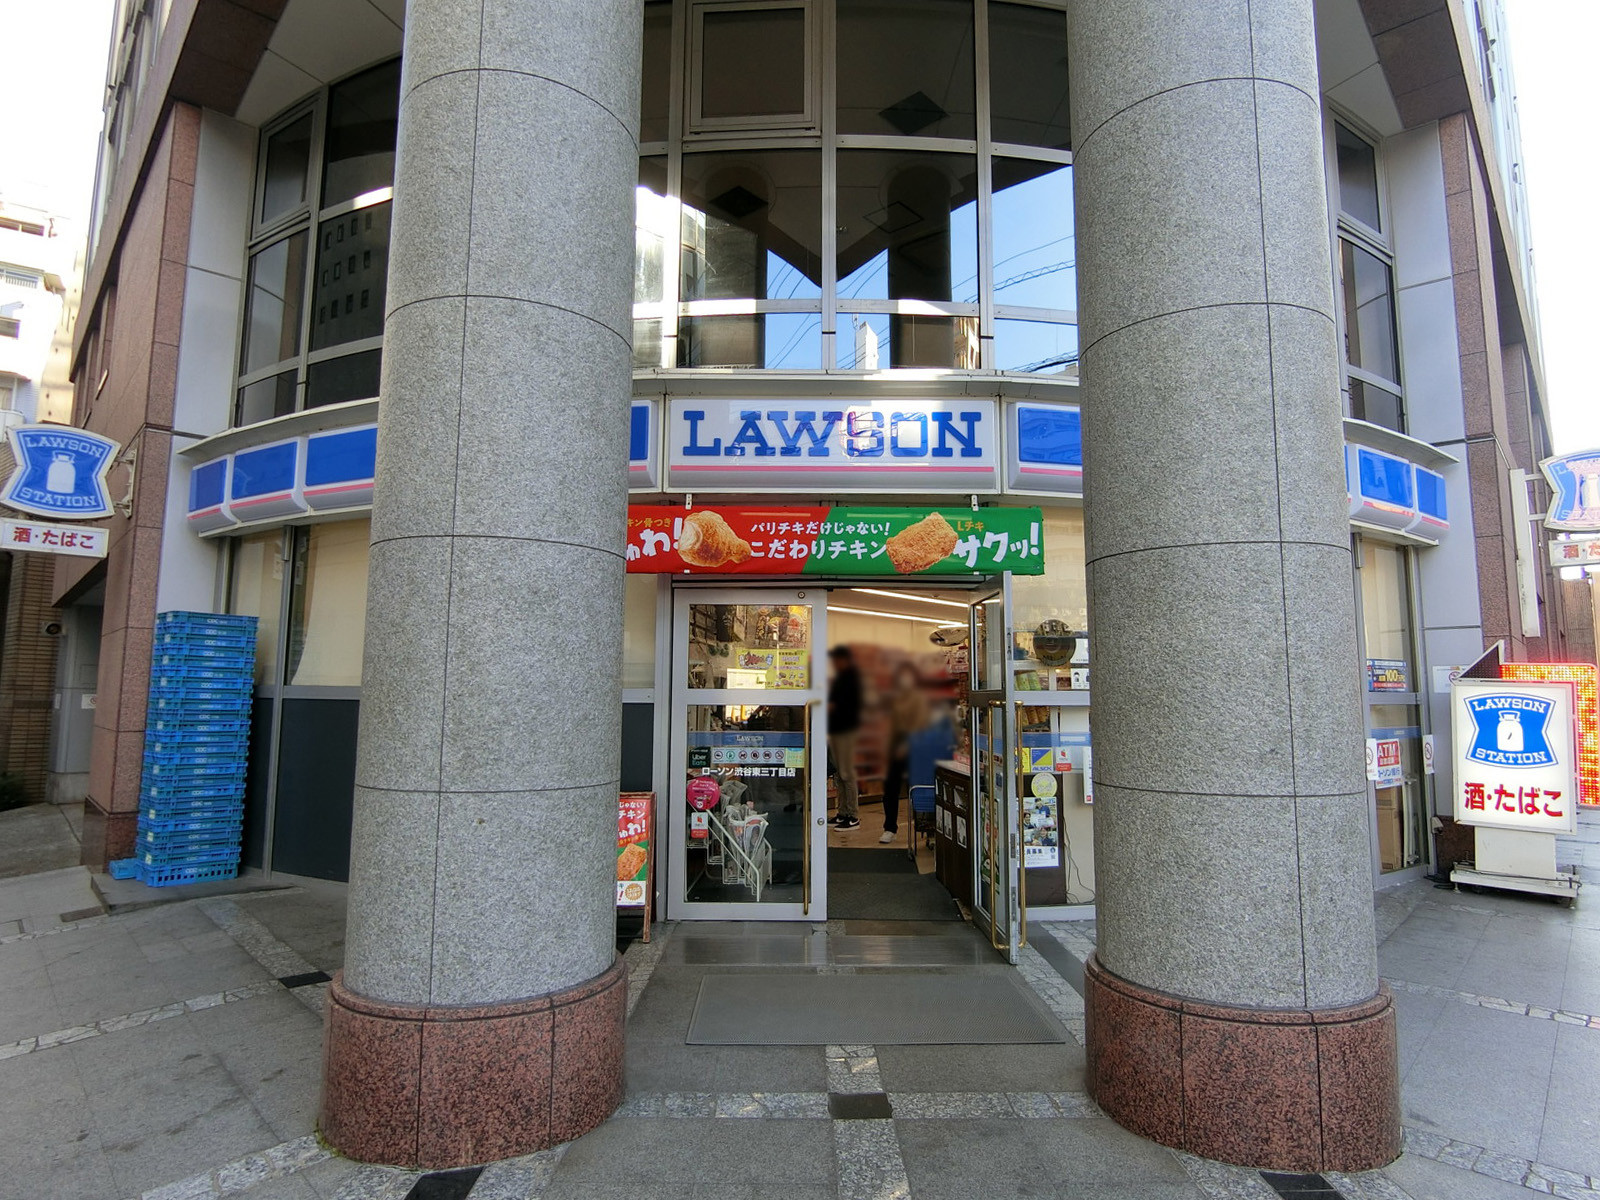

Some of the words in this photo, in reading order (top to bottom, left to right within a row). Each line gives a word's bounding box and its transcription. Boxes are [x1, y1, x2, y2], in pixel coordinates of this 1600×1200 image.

[682, 410, 983, 458] LAWSON
[25, 436, 104, 458] LAWSON
[20, 486, 97, 507] STATION
[751, 521, 891, 536] パリチキだけじゃない!
[957, 520, 984, 532] Lチキ
[13, 526, 94, 549] 酒・たばこ
[953, 522, 1040, 568] サクッ!
[750, 538, 888, 559] こだわりチキン
[1472, 697, 1547, 714] LAWSON
[1474, 747, 1548, 764] STATION
[1464, 782, 1563, 818] 酒・たばこ
